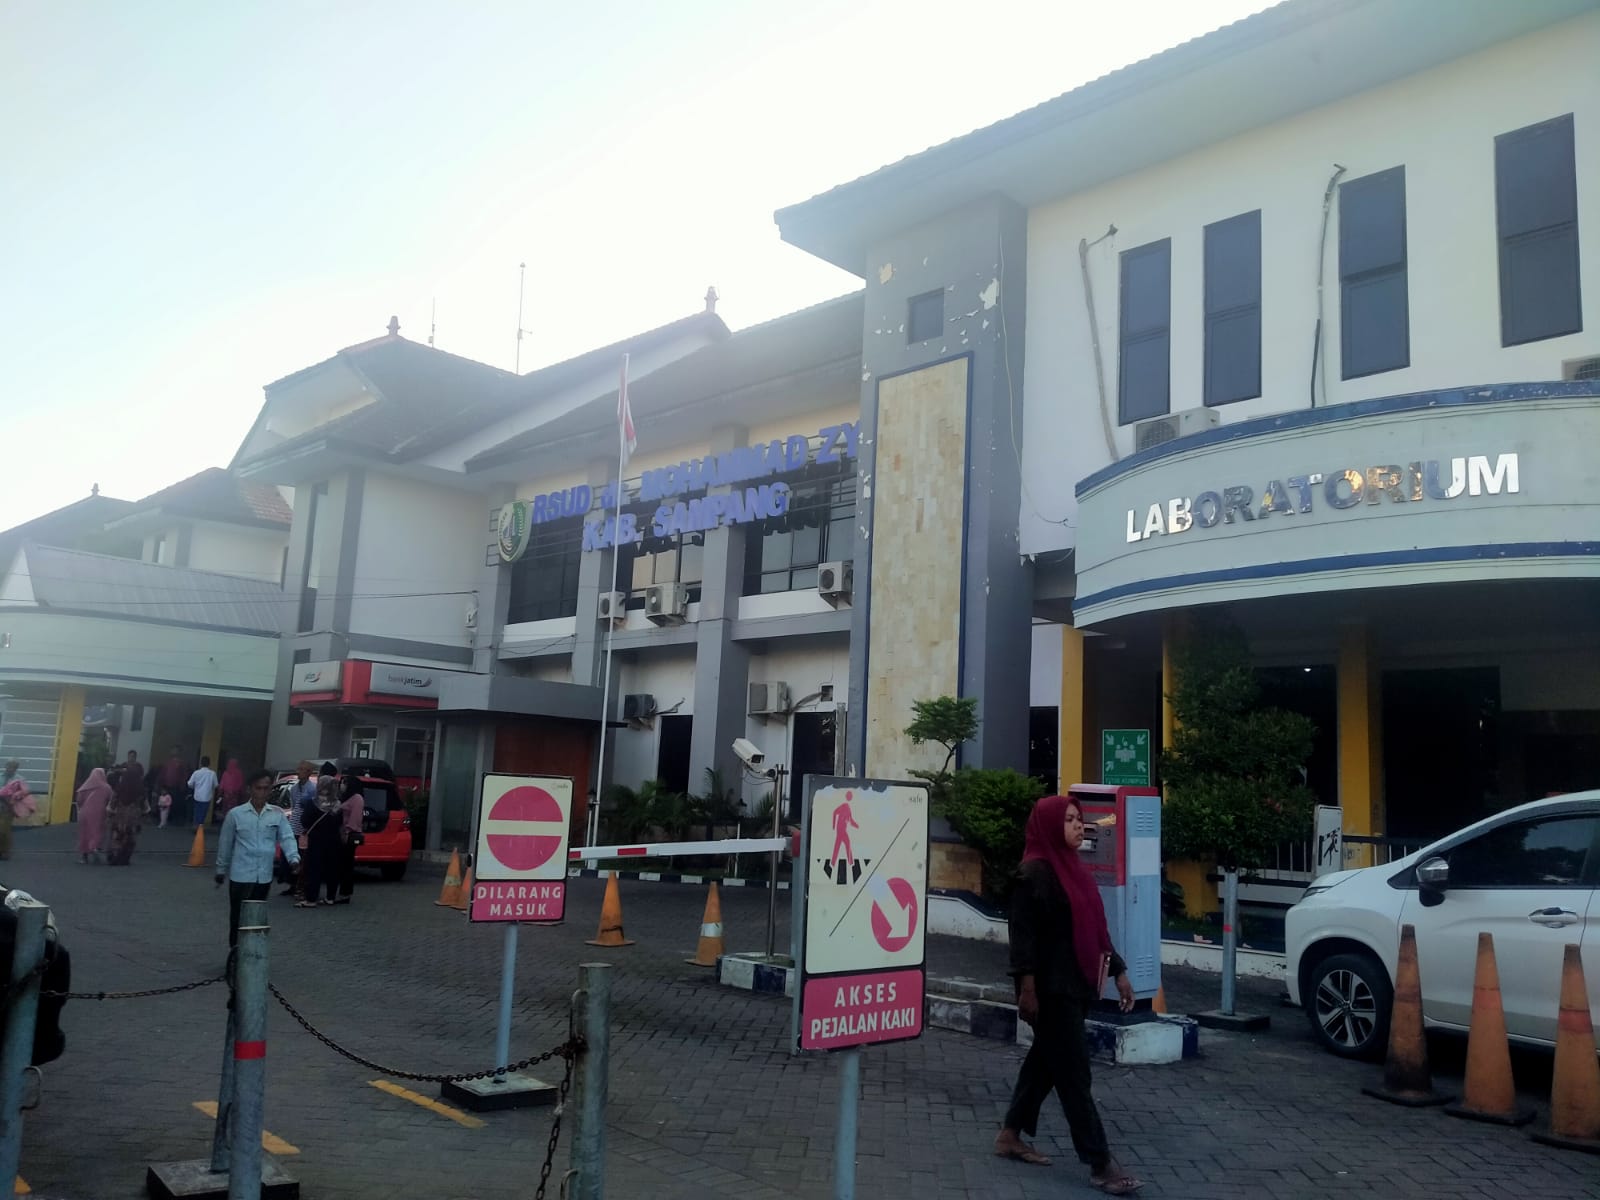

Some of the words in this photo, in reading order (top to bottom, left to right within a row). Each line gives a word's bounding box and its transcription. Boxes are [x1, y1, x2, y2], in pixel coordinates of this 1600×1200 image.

[533, 484, 593, 523] RSUD
[640, 434, 808, 502] MOHAMMAD
[1126, 453, 1521, 543] LABORATORIUM
[582, 513, 643, 552] KAB.
[652, 481, 791, 538] SAMPANG
[477, 886, 561, 899] DILARANG
[490, 903, 547, 916] MASUK
[834, 982, 897, 1008] AKSES
[810, 1012, 877, 1040] PEJALAN
[881, 1007, 915, 1030] KAKI
